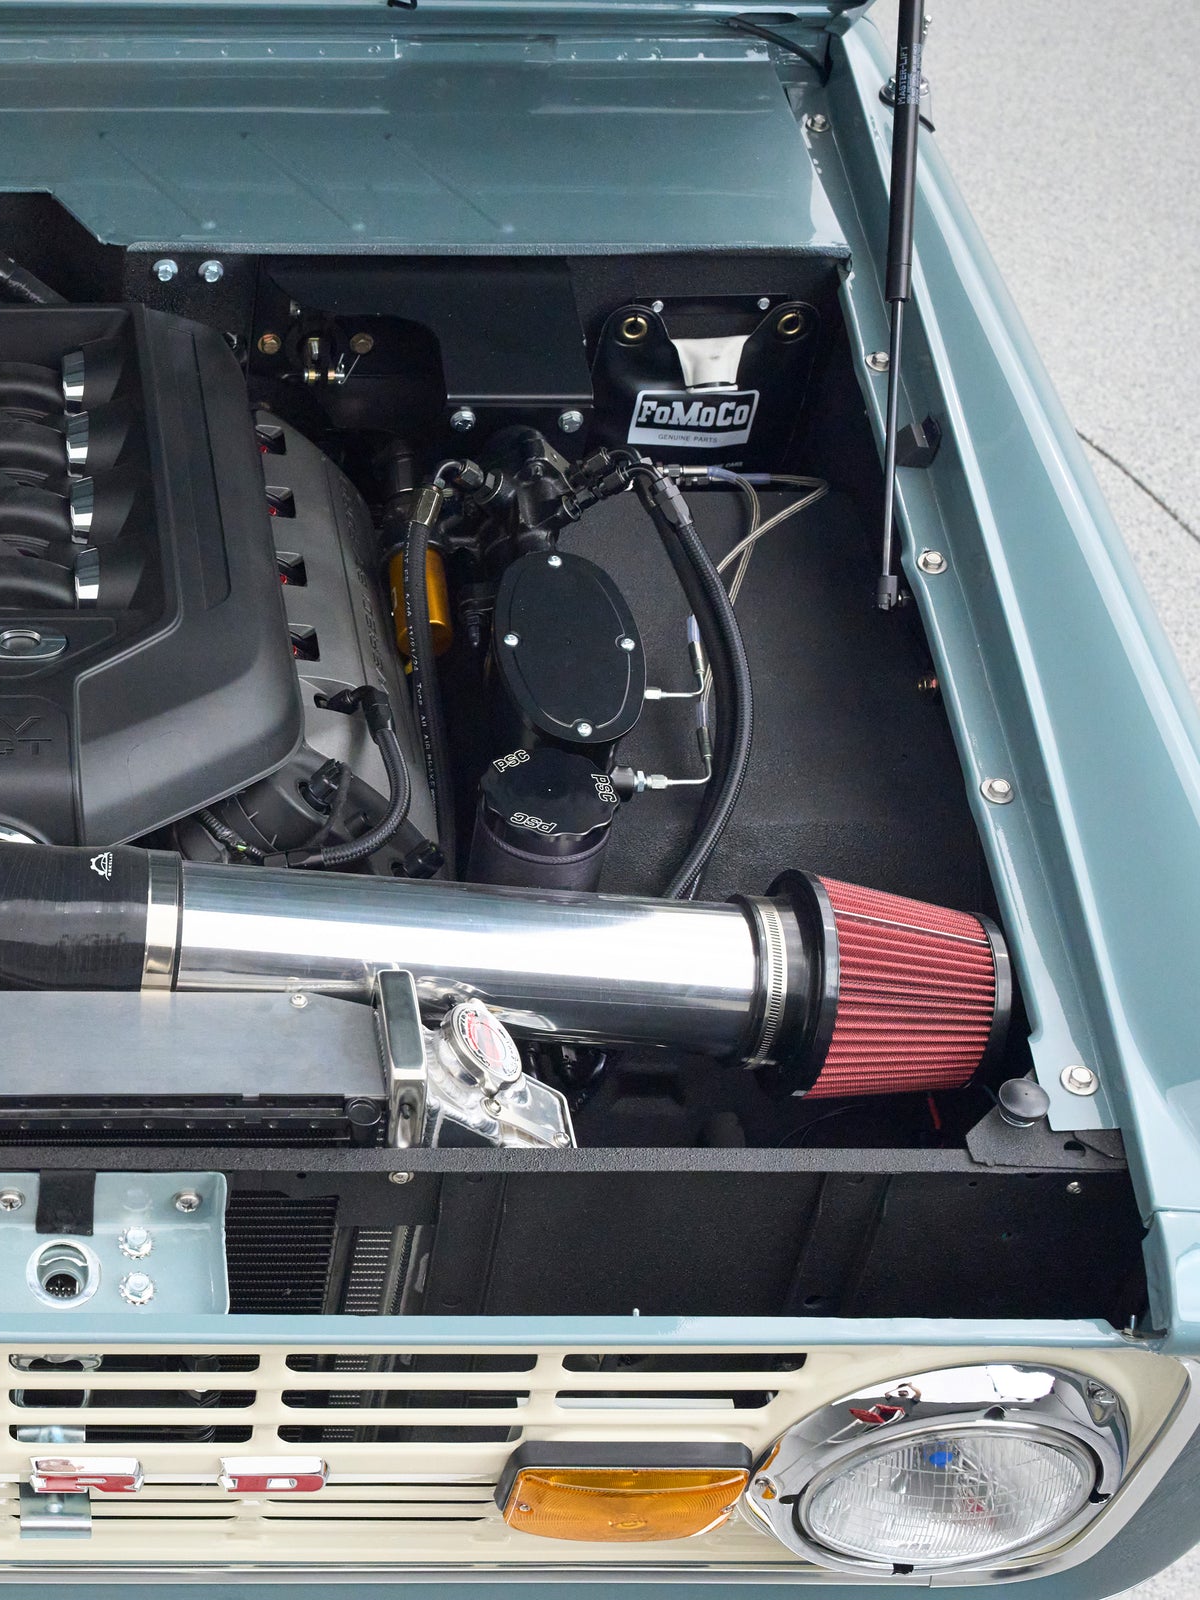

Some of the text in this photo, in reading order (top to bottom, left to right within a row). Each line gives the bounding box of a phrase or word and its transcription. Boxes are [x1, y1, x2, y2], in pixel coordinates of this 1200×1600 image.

[637, 401, 750, 427] FoMoCo
[658, 433, 718, 443] GENUINE PARTS
[493, 749, 531, 773] PSC
[590, 773, 617, 803] PSC
[509, 811, 558, 834] PSC
